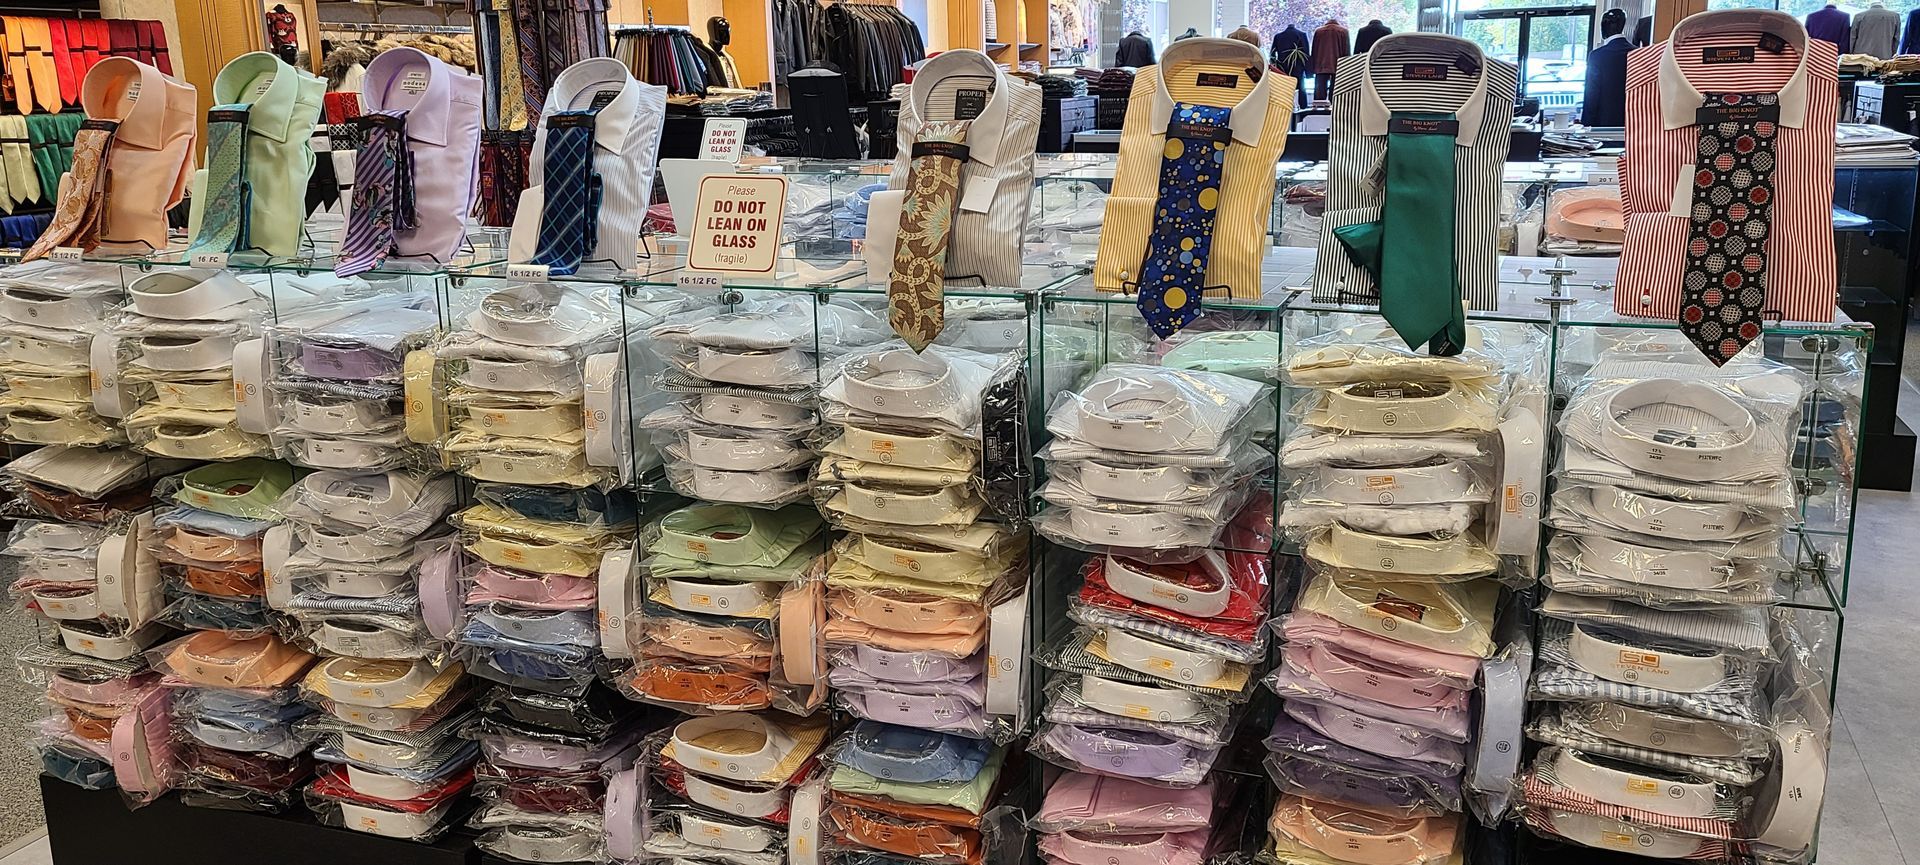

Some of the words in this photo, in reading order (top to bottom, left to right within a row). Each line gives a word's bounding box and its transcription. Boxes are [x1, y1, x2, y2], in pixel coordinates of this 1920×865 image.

[958, 90, 985, 98] PROPER
[710, 145, 732, 153] GLASS
[727, 185, 756, 196] Please
[713, 200, 733, 214] DO
[737, 201, 766, 214] NOT
[707, 217, 743, 231] LEAN
[747, 218, 767, 231] ON
[712, 234, 757, 249] GLASS
[714, 252, 748, 265] (fragile)
[520, 270, 531, 278] 1/2
[532, 270, 542, 278] FC
[691, 277, 704, 285] 1/2
